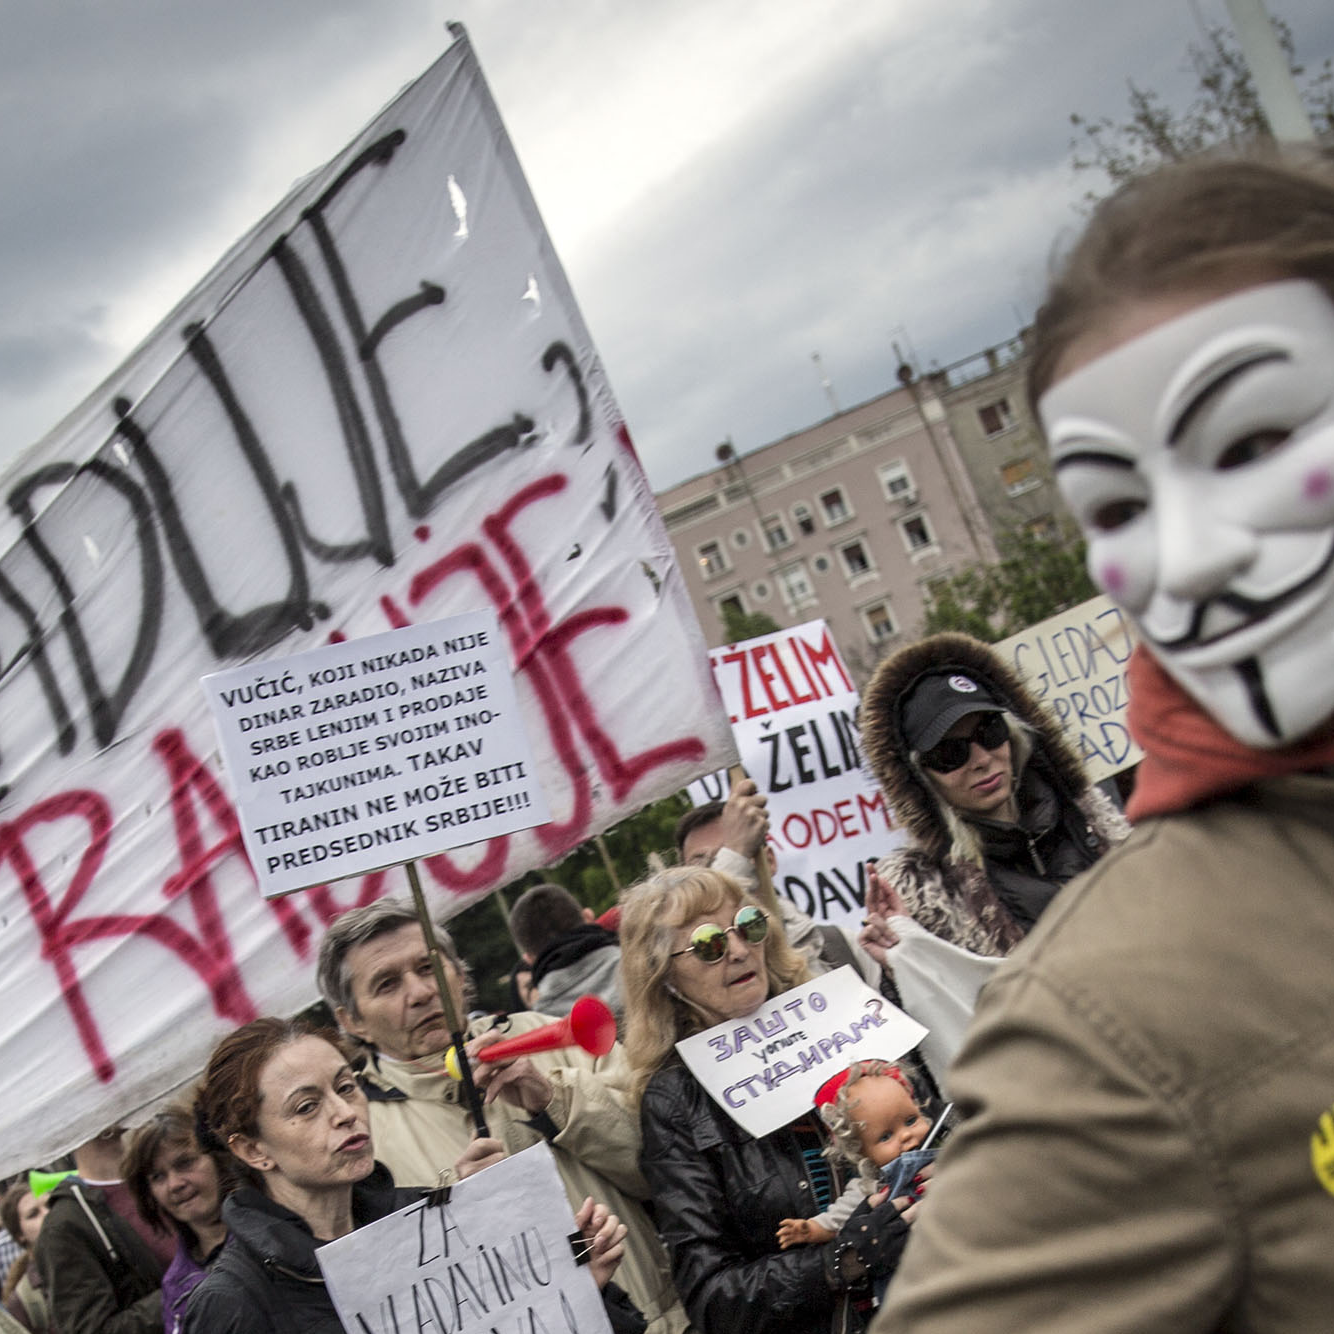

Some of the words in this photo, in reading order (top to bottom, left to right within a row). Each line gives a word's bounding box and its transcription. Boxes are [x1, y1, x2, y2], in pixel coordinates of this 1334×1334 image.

[220, 670, 304, 708] VUČIĆ,
[308, 662, 355, 689] KOJI
[362, 645, 439, 674] NIKADA
[444, 631, 489, 655] NIJE
[240, 704, 304, 733] DINAR
[310, 683, 406, 716] ZARADIO,
[411, 660, 487, 690] NAZIVA
[722, 627, 855, 720] ŽELIM
[249, 759, 291, 783] KAO
[297, 741, 370, 771] ROBLJE
[375, 722, 449, 752] SVOJIM
[454, 710, 501, 732] INO-
[250, 731, 302, 757] SRBE
[307, 712, 379, 744] LENJIM
[385, 707, 395, 724] I
[400, 685, 488, 717] PRODAJE
[254, 809, 359, 848] TIRANIN
[367, 793, 397, 815] NE
[404, 776, 468, 811] MOŽE
[474, 760, 527, 791] BITI
[280, 766, 402, 806] TAJKUNIMA.
[407, 738, 483, 772] TAKAV
[267, 821, 418, 874] PREDSEDNIK
[425, 790, 532, 834] SRBIJE!!!
[707, 991, 828, 1062] ЗАШТО
[403, 1203, 470, 1268] ZA
